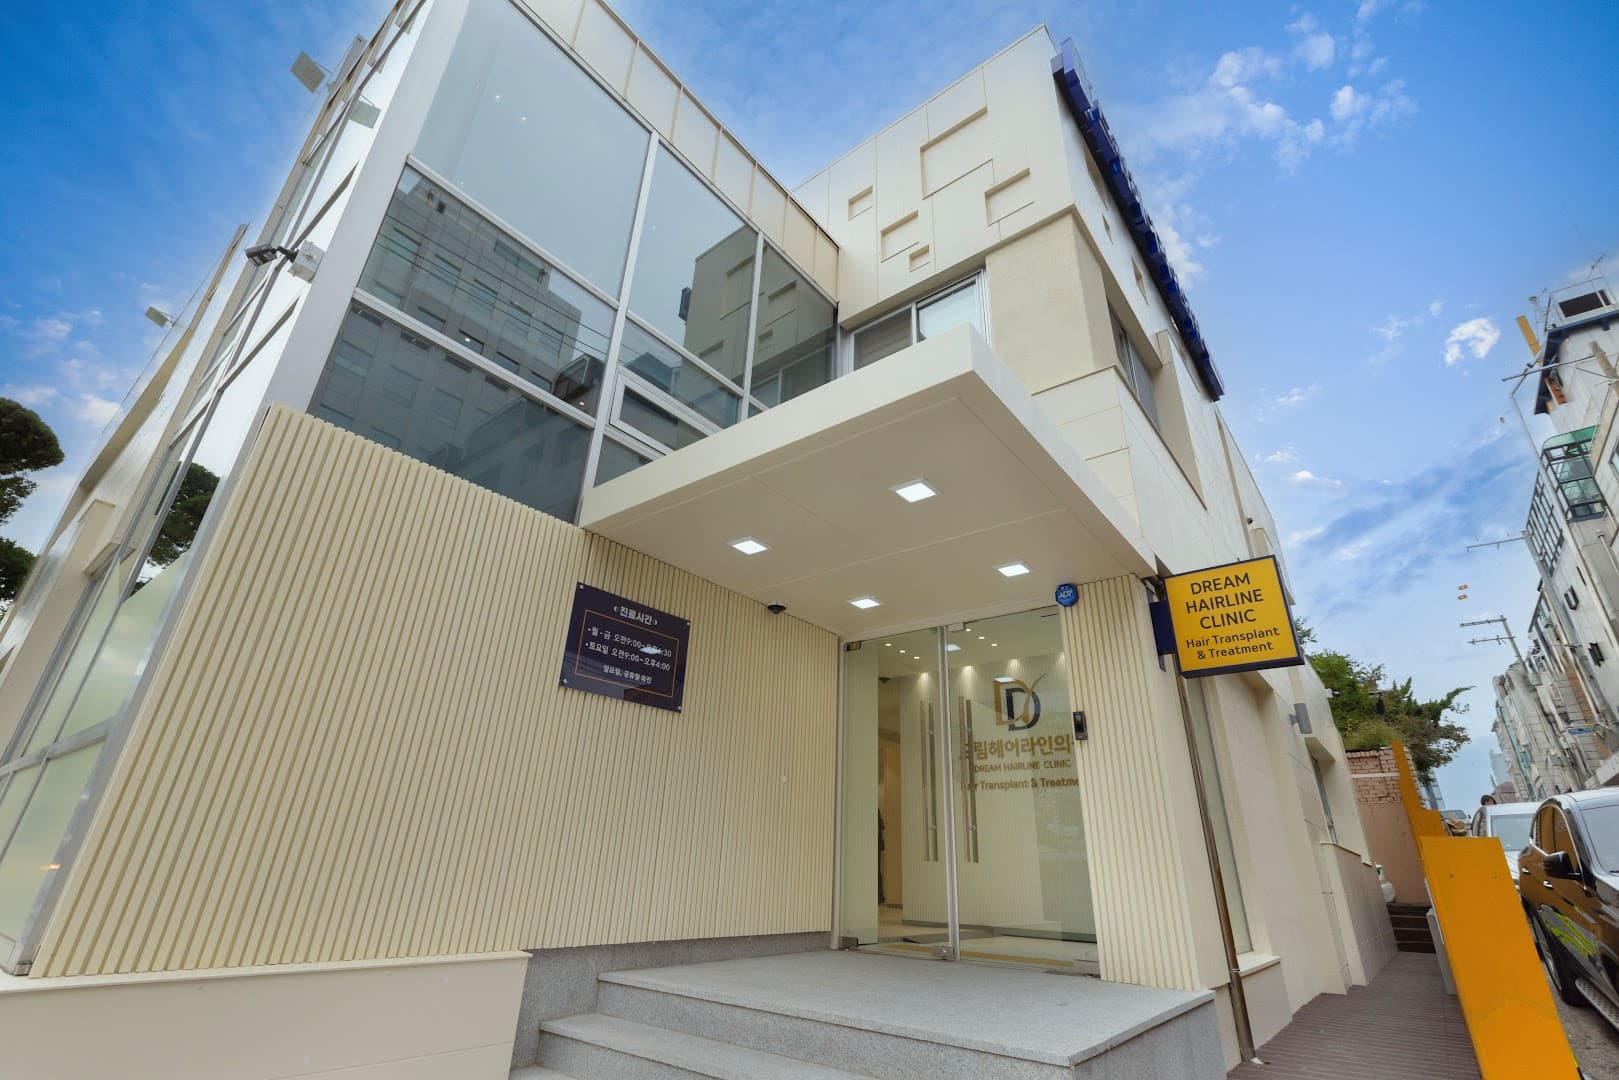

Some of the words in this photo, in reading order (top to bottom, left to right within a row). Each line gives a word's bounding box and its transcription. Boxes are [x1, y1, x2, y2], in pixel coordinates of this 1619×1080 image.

[1190, 572, 1250, 595] DREAM
[1186, 589, 1264, 614] HAIRLINE
[1200, 609, 1257, 629] CLINIC
[1186, 637, 1210, 648] Hair
[1212, 626, 1280, 646] Transplant
[1197, 649, 1206, 660] &
[1209, 641, 1274, 658] Treatment
[959, 733, 1074, 761] 림헤어라인의
[1043, 759, 1072, 769] CLINIC
